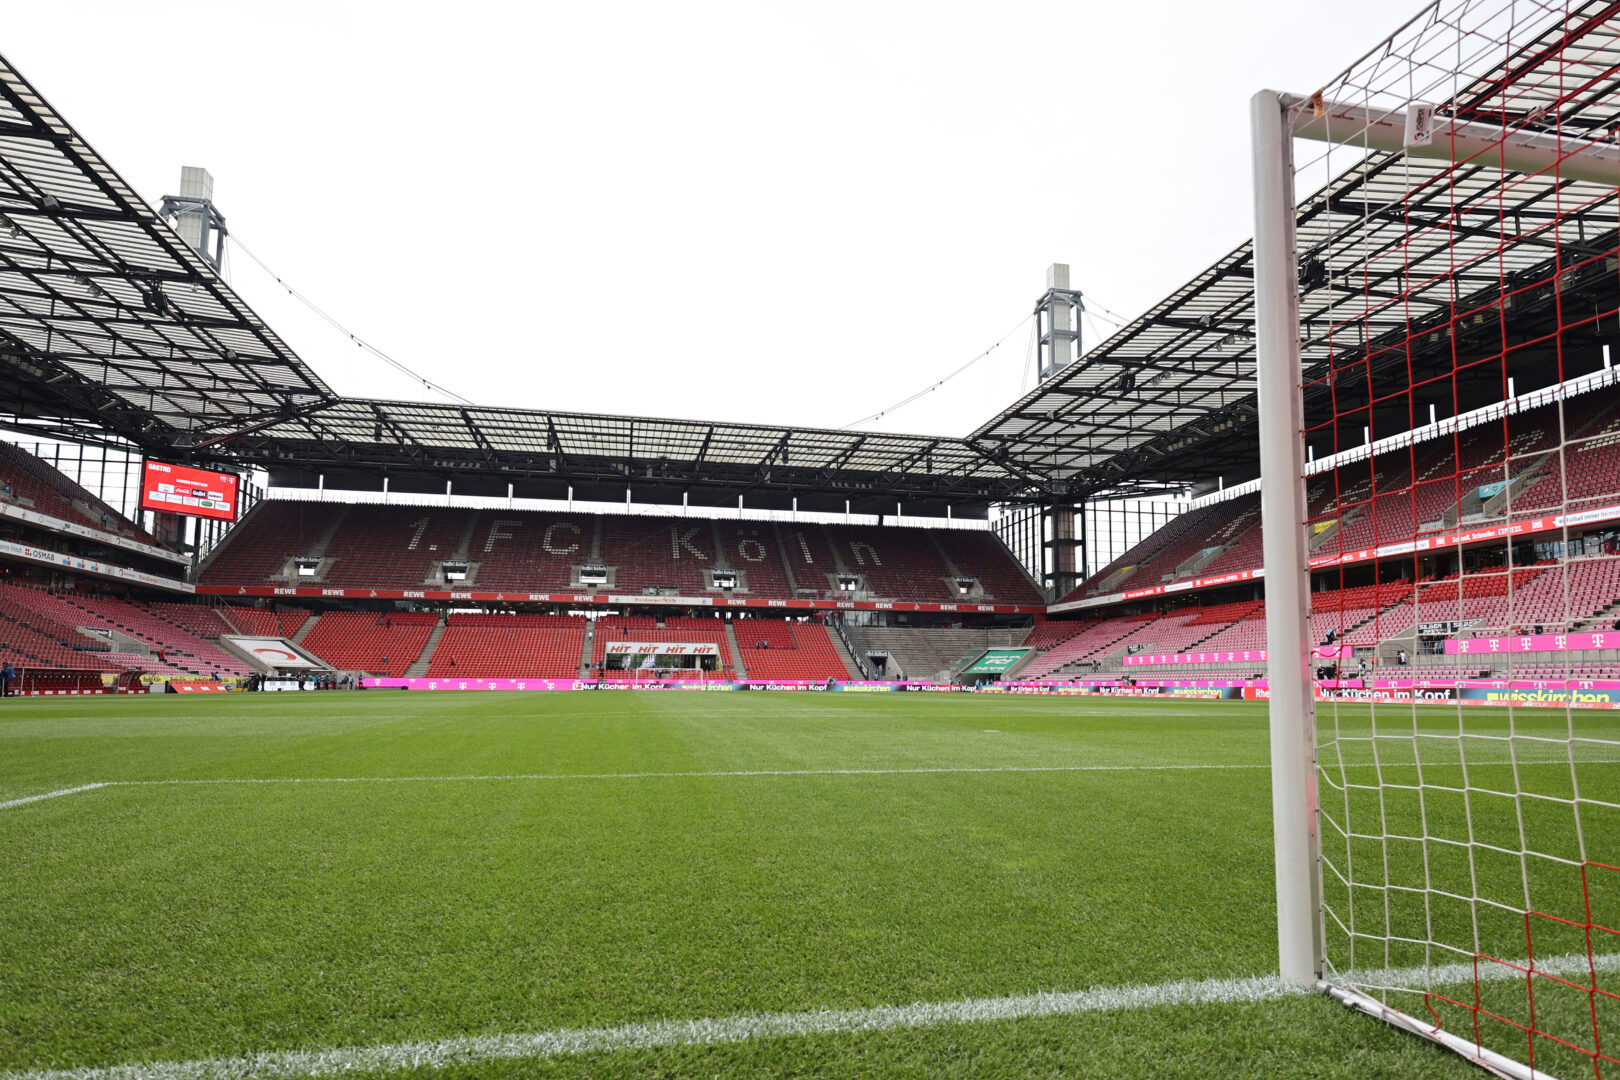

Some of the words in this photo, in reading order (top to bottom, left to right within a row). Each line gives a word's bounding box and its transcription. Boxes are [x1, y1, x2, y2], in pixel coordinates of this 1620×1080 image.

[408, 517, 437, 550] 1.
[484, 520, 580, 554] FC
[671, 527, 882, 566] Köln
[33, 550, 54, 561] OSMAB
[1320, 688, 1337, 697] Nu
[1394, 689, 1410, 699] im
[1415, 689, 1451, 700] Kopf
